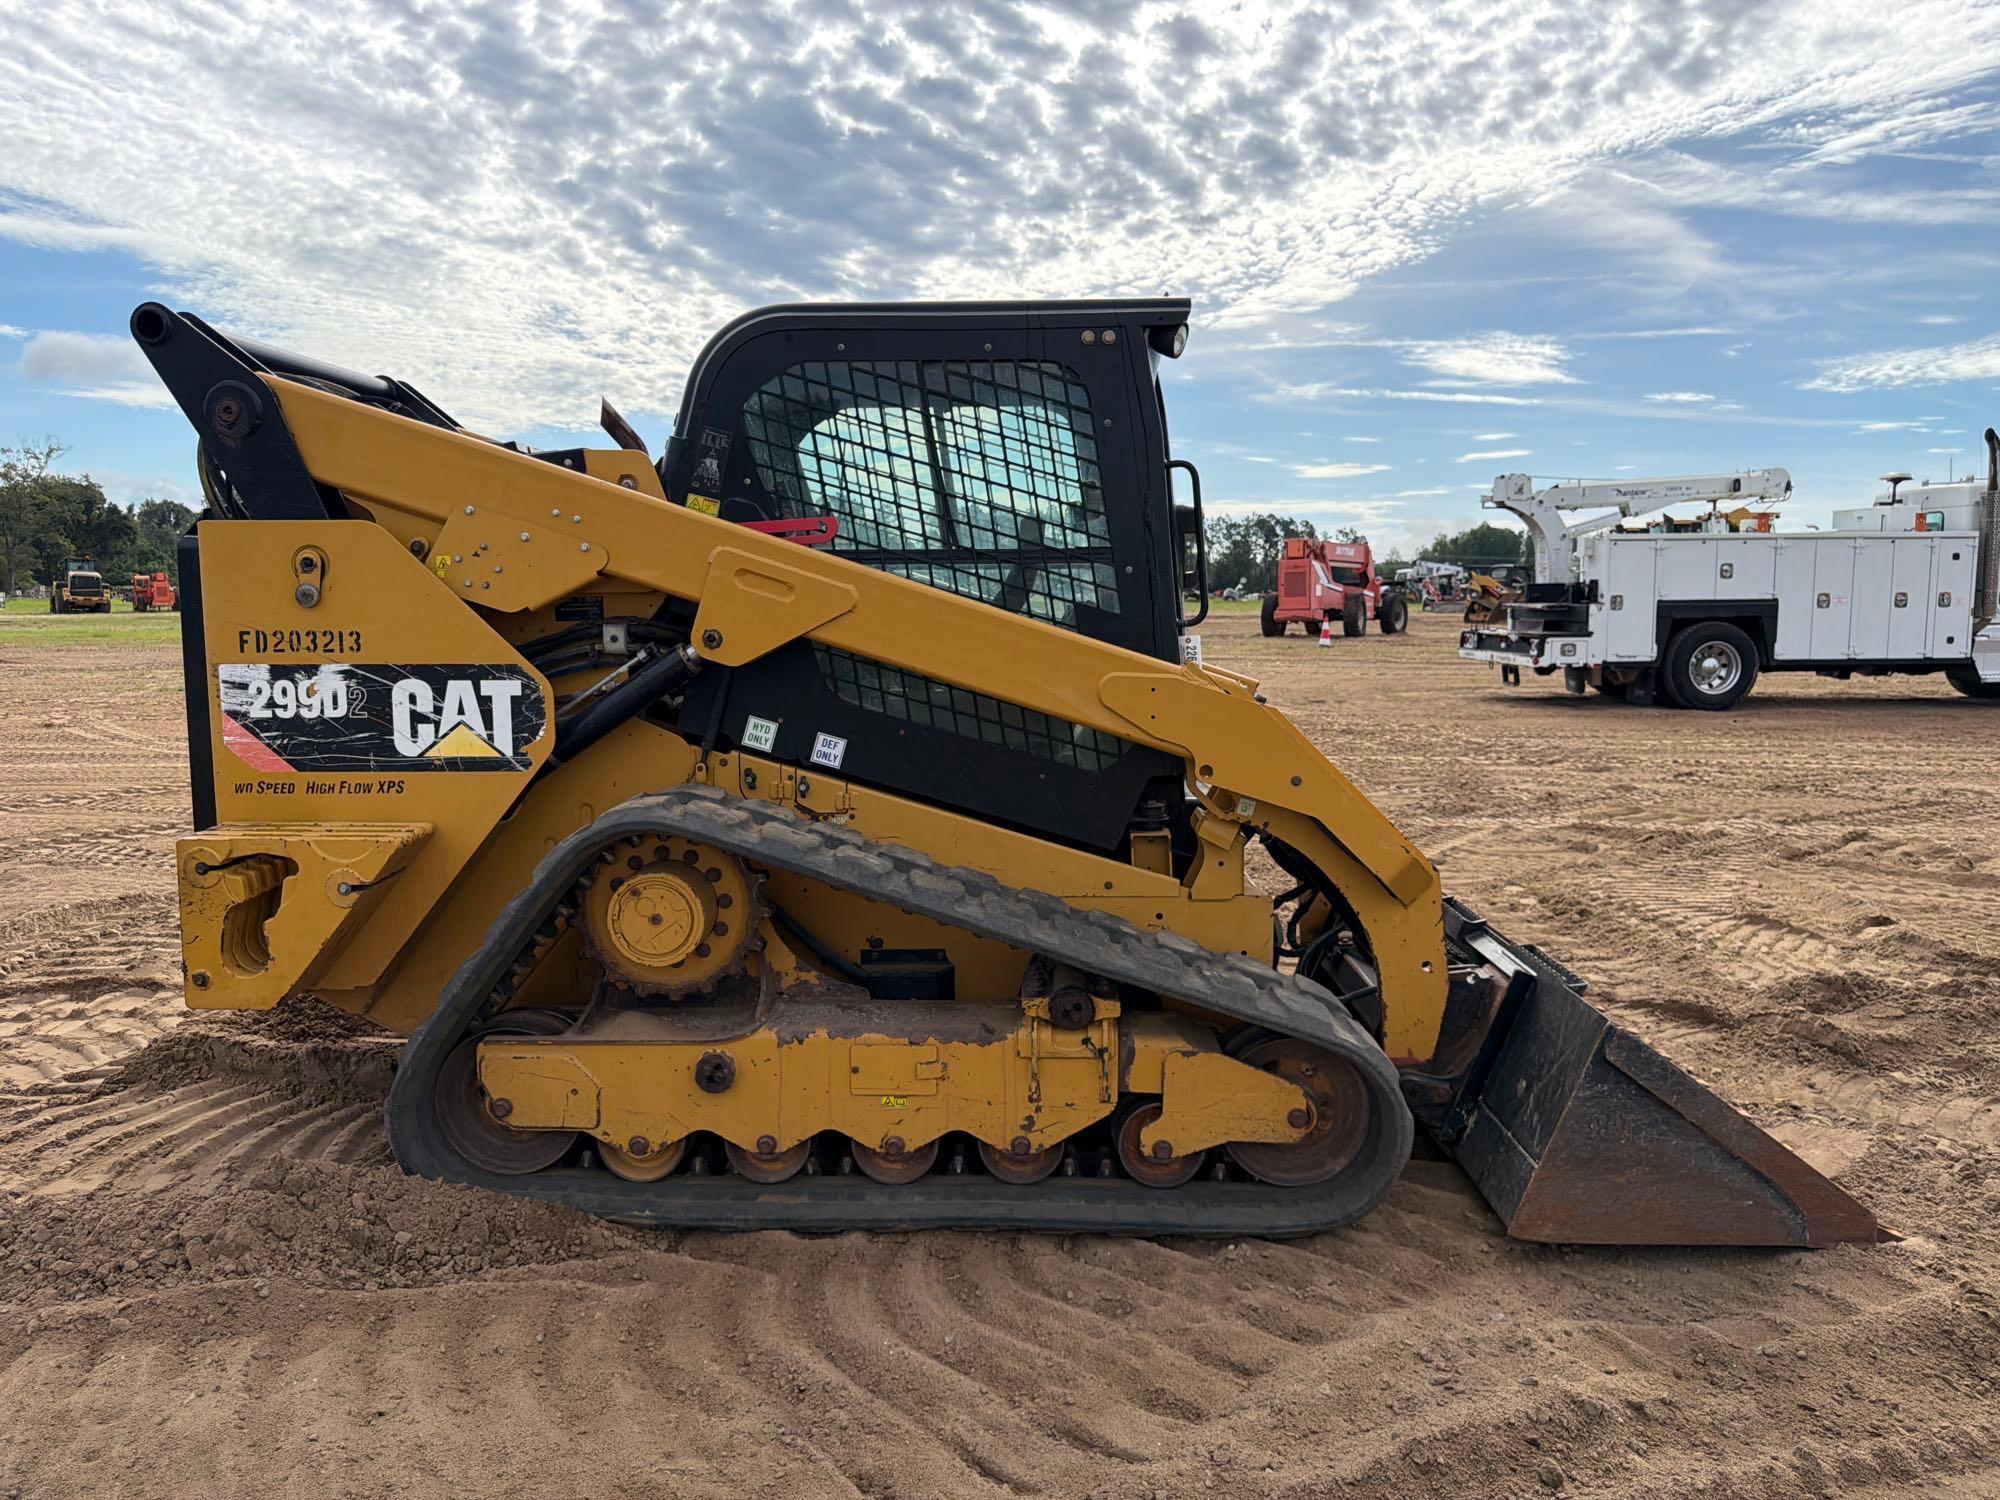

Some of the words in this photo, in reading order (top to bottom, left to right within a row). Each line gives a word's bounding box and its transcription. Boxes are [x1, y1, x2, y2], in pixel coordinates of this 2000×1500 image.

[239, 630, 362, 653] FD203213
[392, 678, 522, 757] CAT
[752, 721, 771, 734] HYD
[747, 733, 770, 746] ONLY
[821, 738, 840, 750] DEF
[815, 750, 839, 764] ONLY
[306, 781, 336, 795] HIGH
[339, 781, 373, 794] FLOW
[377, 780, 405, 794] XPS
